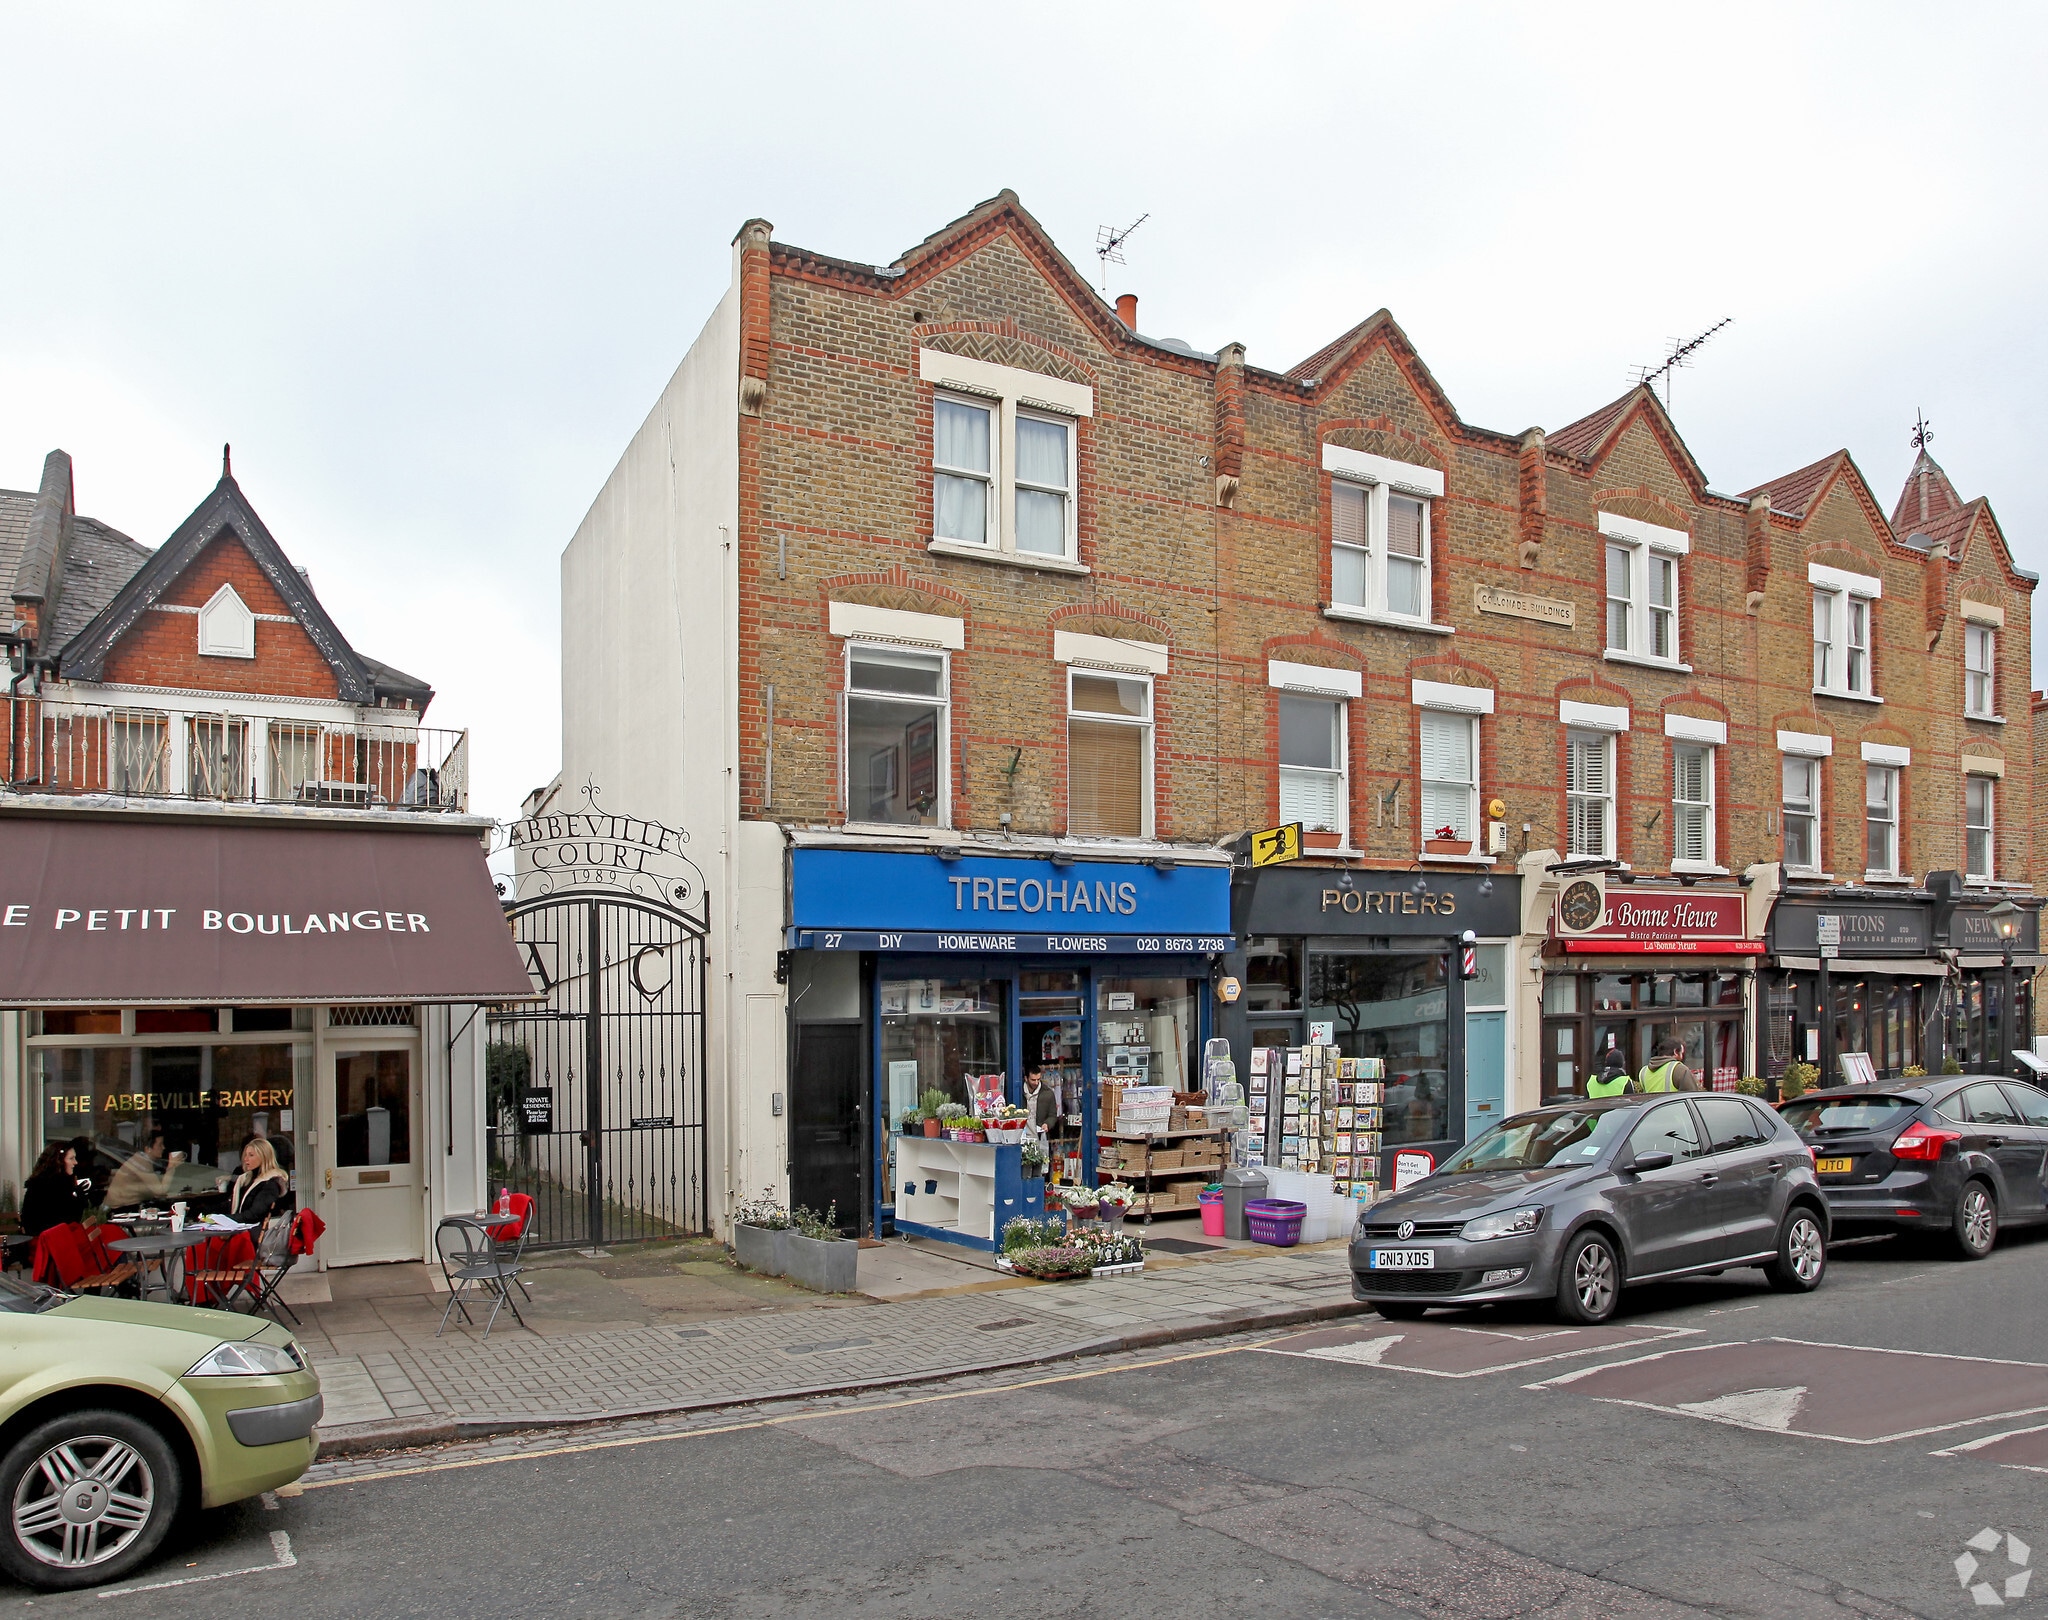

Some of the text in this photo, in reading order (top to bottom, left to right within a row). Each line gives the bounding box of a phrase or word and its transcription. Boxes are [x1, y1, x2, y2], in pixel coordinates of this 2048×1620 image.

[508, 814, 679, 853] ABBEVILLE
[531, 842, 652, 872] COURT
[571, 869, 617, 884] 1989
[948, 876, 1137, 915] TREOHANS
[1321, 889, 1456, 915] PORTERS
[54, 908, 177, 932] PETIT
[202, 909, 431, 934] BOULANGER
[1604, 902, 1718, 928] a Bonne Heure
[1840, 915, 1885, 933] WTONS
[824, 934, 1225, 952] 27 DIY HOMEWARE FLOWERS 020 8673 2738
[1630, 931, 1650, 939] Bistro
[1643, 941, 1654, 950] La
[1654, 941, 1676, 950] Bonne
[1677, 941, 1697, 951] Heure
[632, 943, 665, 995] C
[50, 1089, 293, 1114] THE ABBEVILLE BAKERY
[1821, 1160, 1844, 1171] JTO
[1379, 1252, 1429, 1266] GN13 XDS
